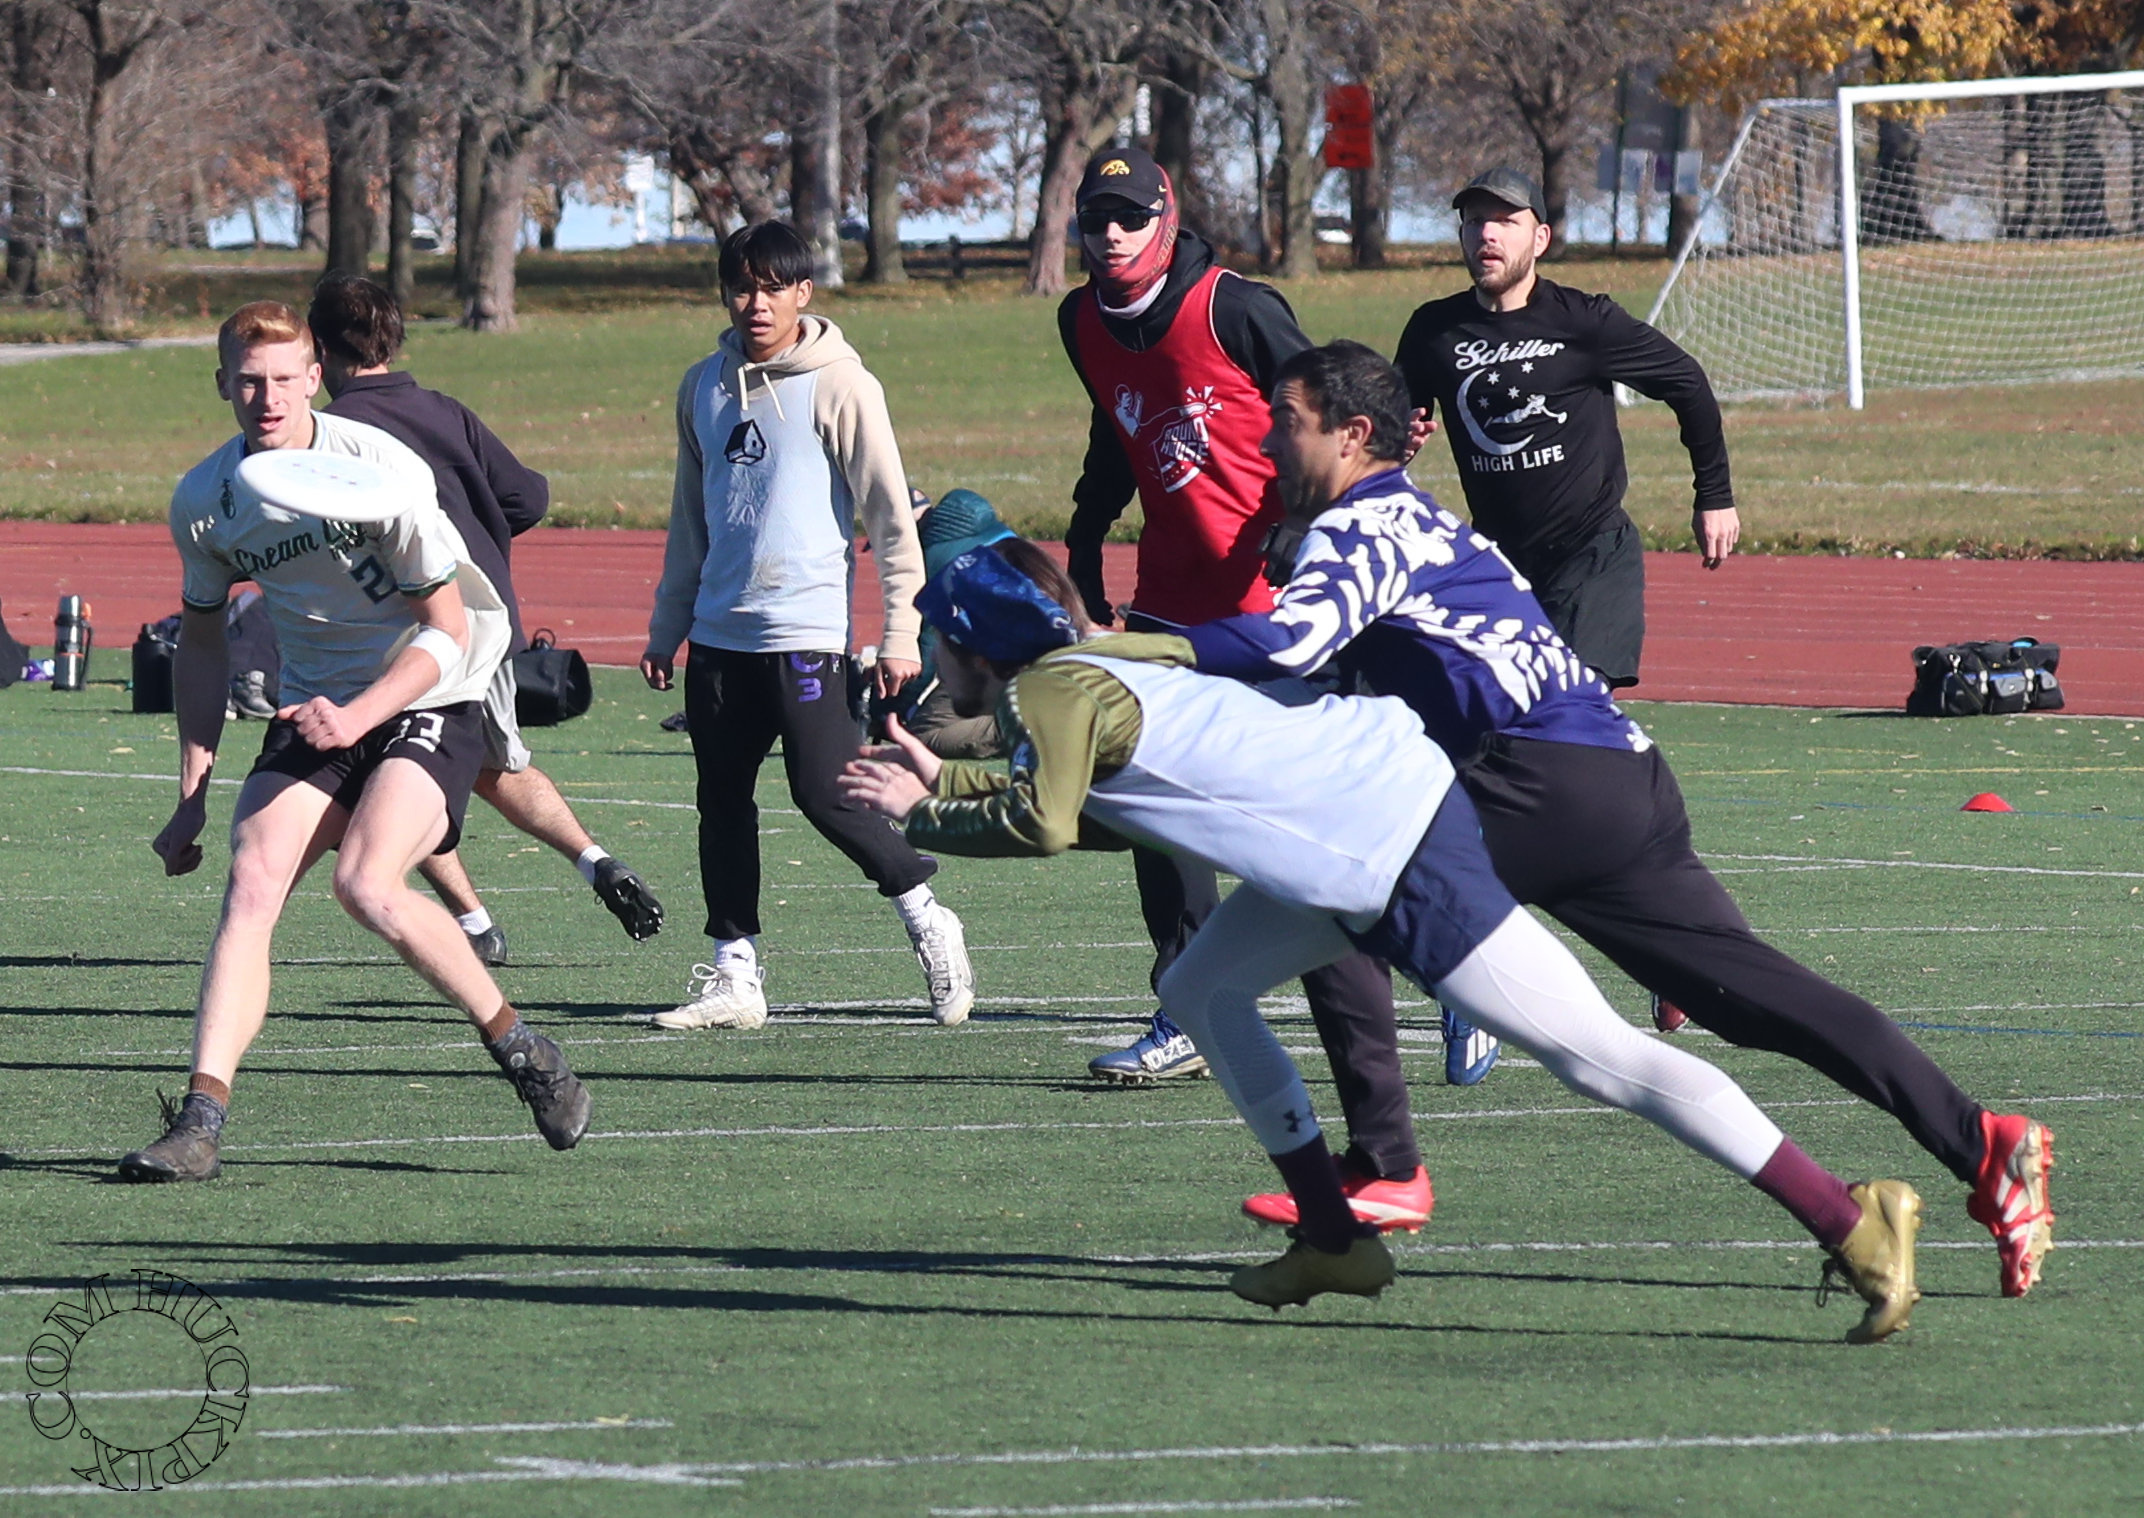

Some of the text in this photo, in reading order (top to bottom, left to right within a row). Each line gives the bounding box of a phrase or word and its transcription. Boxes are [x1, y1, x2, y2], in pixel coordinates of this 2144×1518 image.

[1454, 339, 1565, 370] Schiller
[1165, 416, 1209, 444] ROUND
[1471, 444, 1565, 472] HIGH LIFE
[235, 531, 320, 574] Cream
